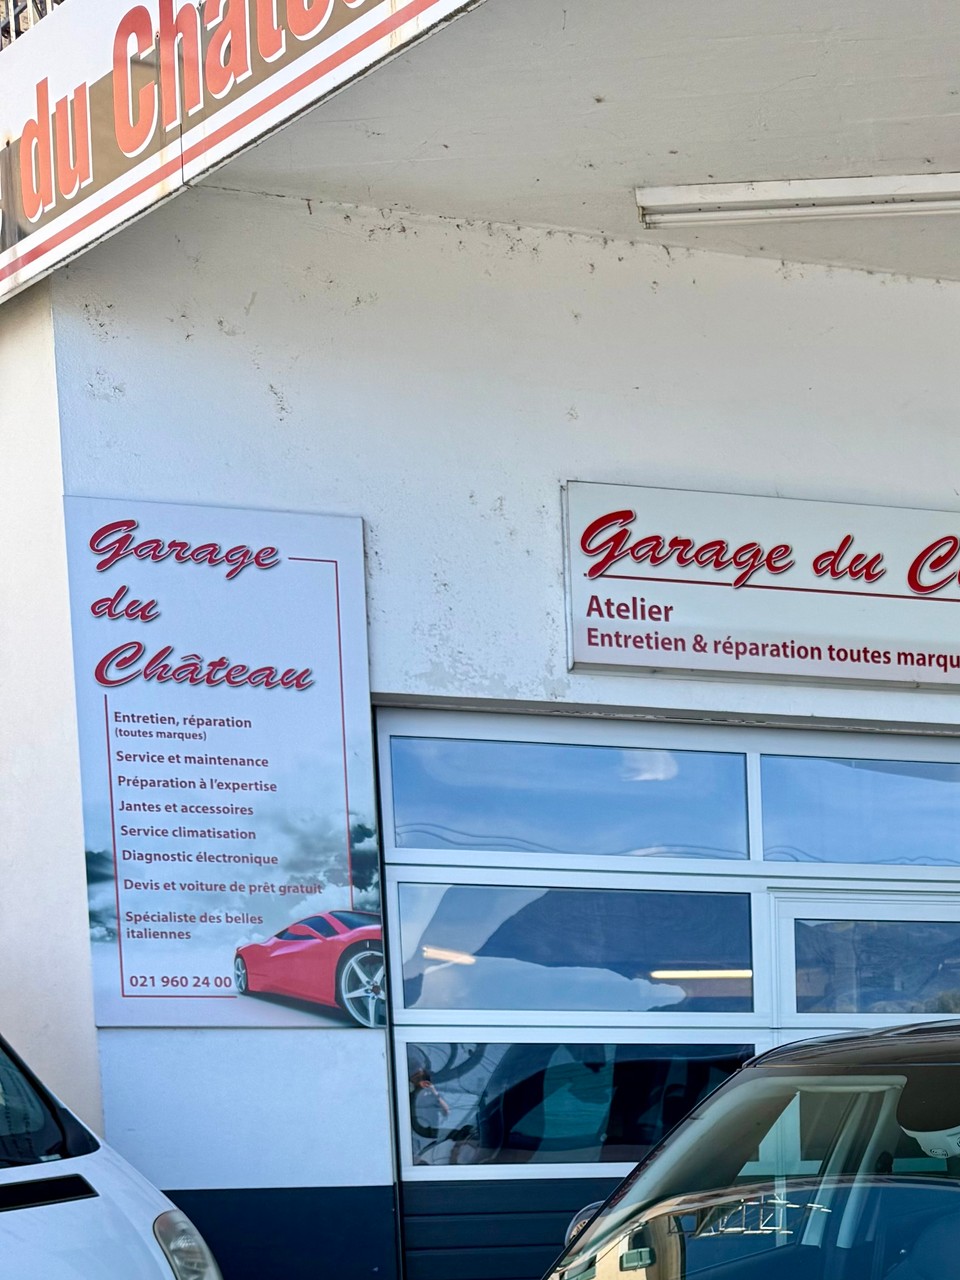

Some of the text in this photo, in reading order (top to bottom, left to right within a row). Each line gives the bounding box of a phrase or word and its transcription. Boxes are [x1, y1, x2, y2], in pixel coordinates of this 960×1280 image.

[20, 76, 93, 223] du
[90, 520, 279, 580] Garage
[581, 510, 794, 589] Garage
[813, 535, 886, 583] du
[91, 585, 160, 623] du
[586, 594, 674, 622] Atelier
[587, 627, 686, 652] Entretien
[692, 634, 708, 654] &
[713, 635, 822, 661] réparation
[827, 644, 892, 665] toutes
[95, 642, 313, 691] Château
[114, 711, 252, 729] Entretien, réparation
[114, 727, 207, 742] (toutes marques)
[116, 750, 269, 768] Service et maintenance
[117, 775, 196, 790] Préparation
[118, 800, 254, 816] Jantes et accessoires
[120, 824, 257, 840] Service climatisation
[122, 849, 279, 867] Diagnostic électronique
[123, 878, 323, 896] Devis et voiture de prêt gratuit
[125, 911, 264, 925] Spécialiste des belles
[126, 927, 192, 940] italiennes
[129, 975, 232, 988] 021 960 24 00
